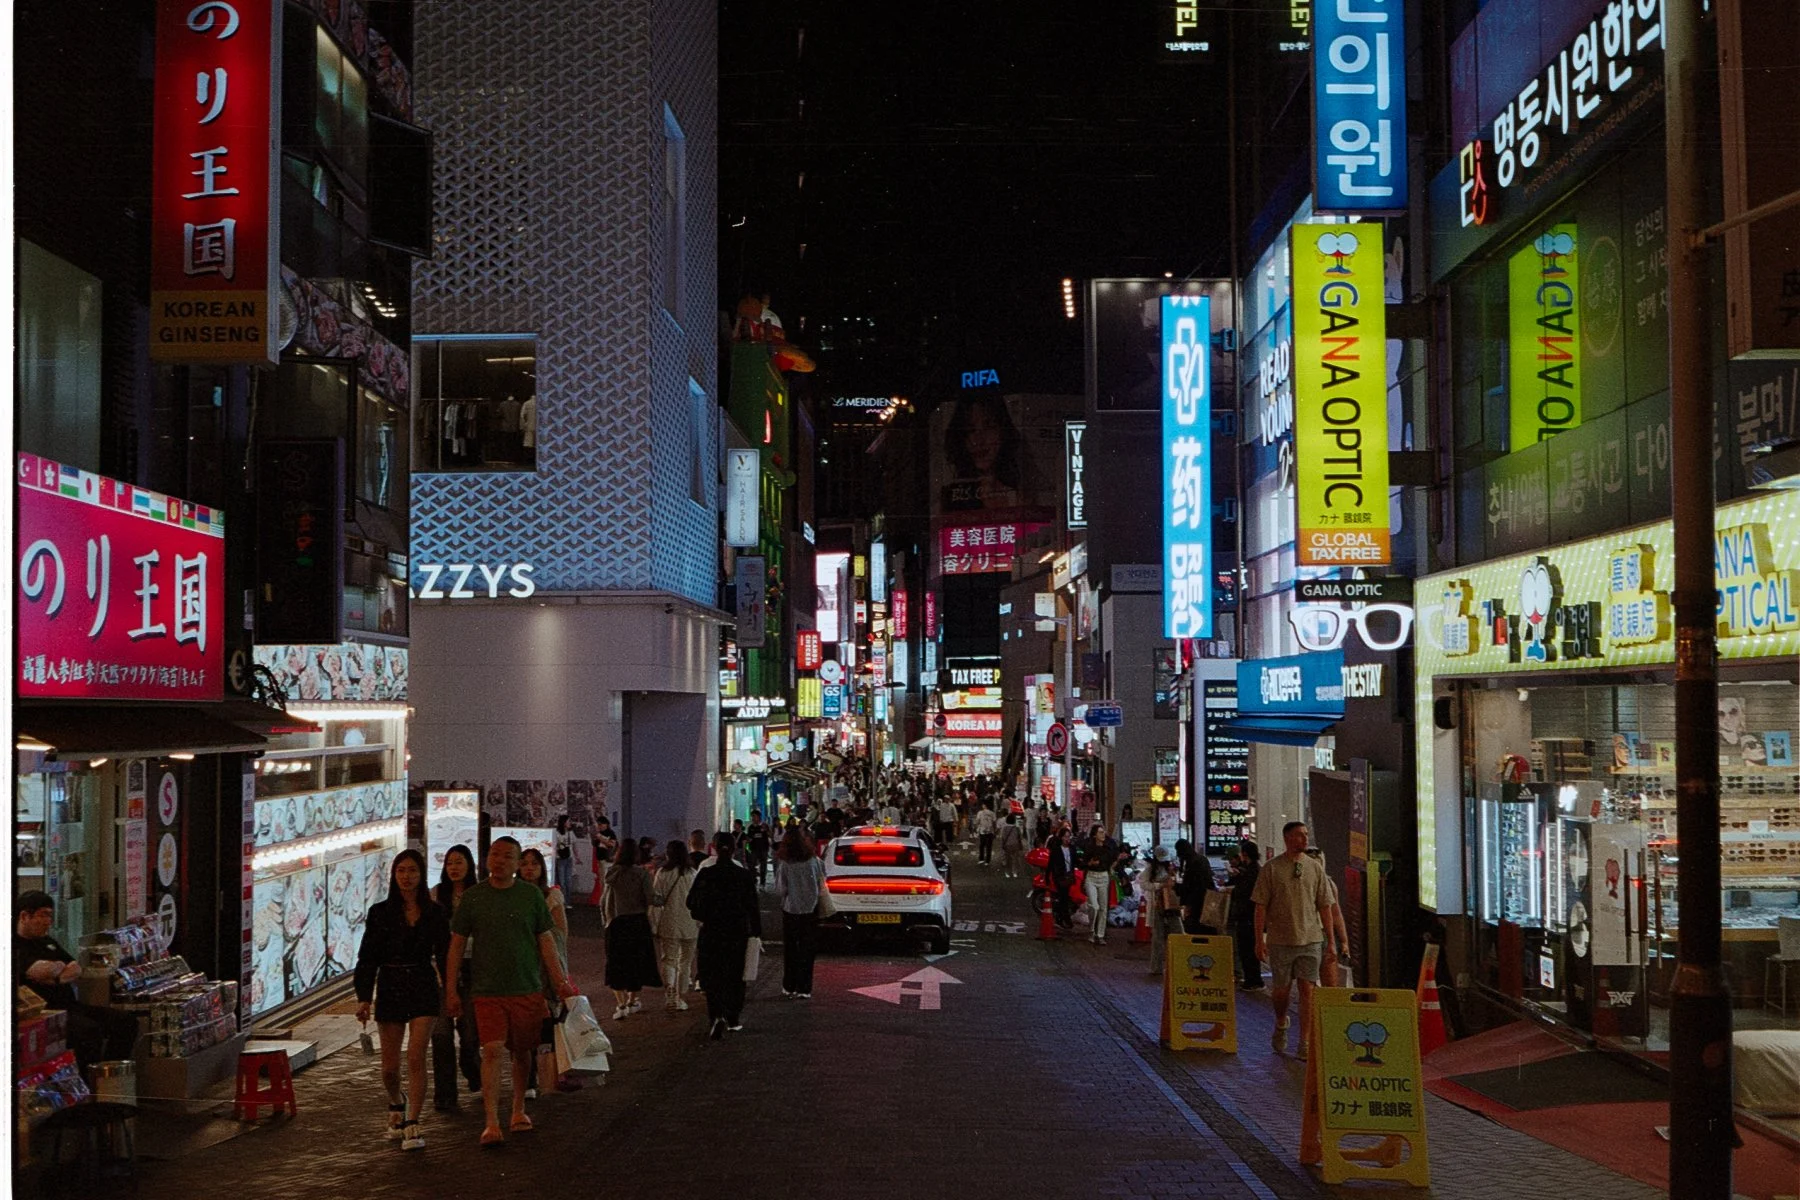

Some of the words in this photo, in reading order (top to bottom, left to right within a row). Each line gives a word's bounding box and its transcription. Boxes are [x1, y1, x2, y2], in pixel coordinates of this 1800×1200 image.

[1494, 0, 1668, 188] 명동시원한의
[181, 0, 240, 280] のリ王国
[163, 301, 255, 319] KOREAN
[158, 326, 260, 344] GINSENG
[1319, 281, 1360, 389] GANA
[961, 368, 1000, 389] RIFA
[1322, 397, 1363, 508] OPTIC
[1071, 429, 1084, 520] VINTAGE
[949, 525, 1016, 548] 美容医院
[1311, 533, 1376, 547] GLOBAL
[943, 552, 1016, 573] 容クリニ
[1308, 547, 1338, 560] TAX
[1341, 547, 1381, 560] FREE
[410, 563, 535, 598] ZZYS
[19, 534, 207, 652] のリ王国
[1302, 583, 1342, 597] GANA
[1344, 583, 1383, 597] OPTIC
[951, 669, 969, 685] TAX
[970, 669, 993, 685] FREE
[824, 686, 840, 696] GS
[825, 696, 839, 706] 25
[737, 707, 770, 717] ADLV
[948, 720, 985, 731] KOREA
[1176, 986, 1201, 997] GANA
[1202, 986, 1228, 998] OPTIC
[1329, 1075, 1369, 1092] GANA
[1371, 1075, 1411, 1093] OPTIC
[1331, 1100, 1363, 1116] カナ
